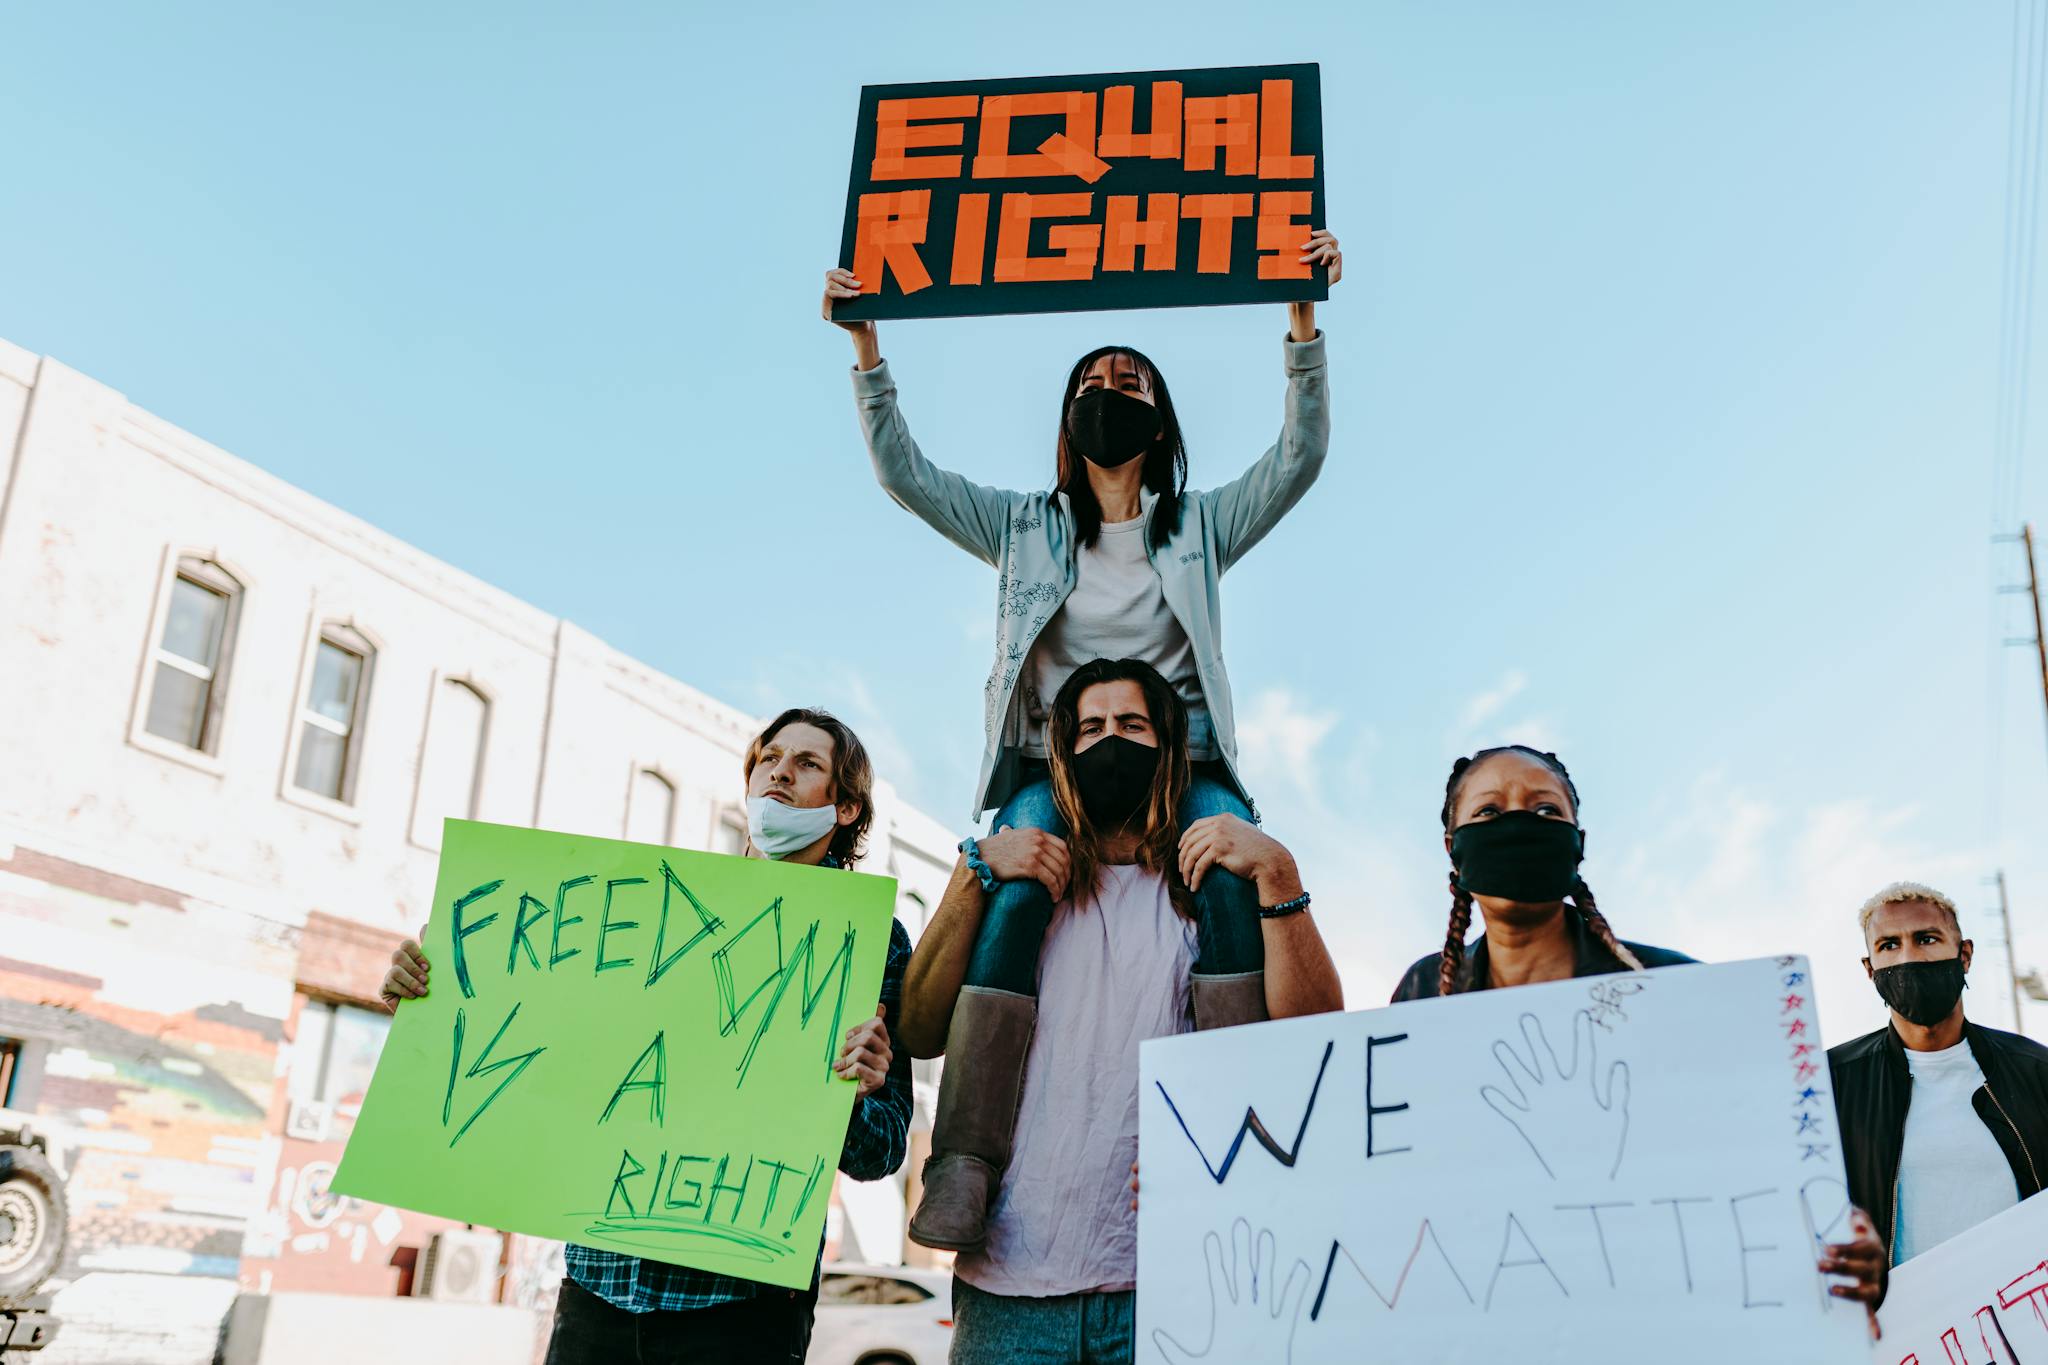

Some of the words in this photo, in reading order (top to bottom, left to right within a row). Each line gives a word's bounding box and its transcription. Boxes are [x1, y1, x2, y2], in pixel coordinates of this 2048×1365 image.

[870, 79, 1315, 184] EQUAL
[853, 189, 1313, 295] RIGHTS
[452, 858, 856, 1089] FREEDOM
[442, 1002, 547, 1148] IS
[598, 1030, 667, 1128] A
[1156, 1036, 1412, 1184] WE
[605, 1149, 826, 1240] RIGHT!
